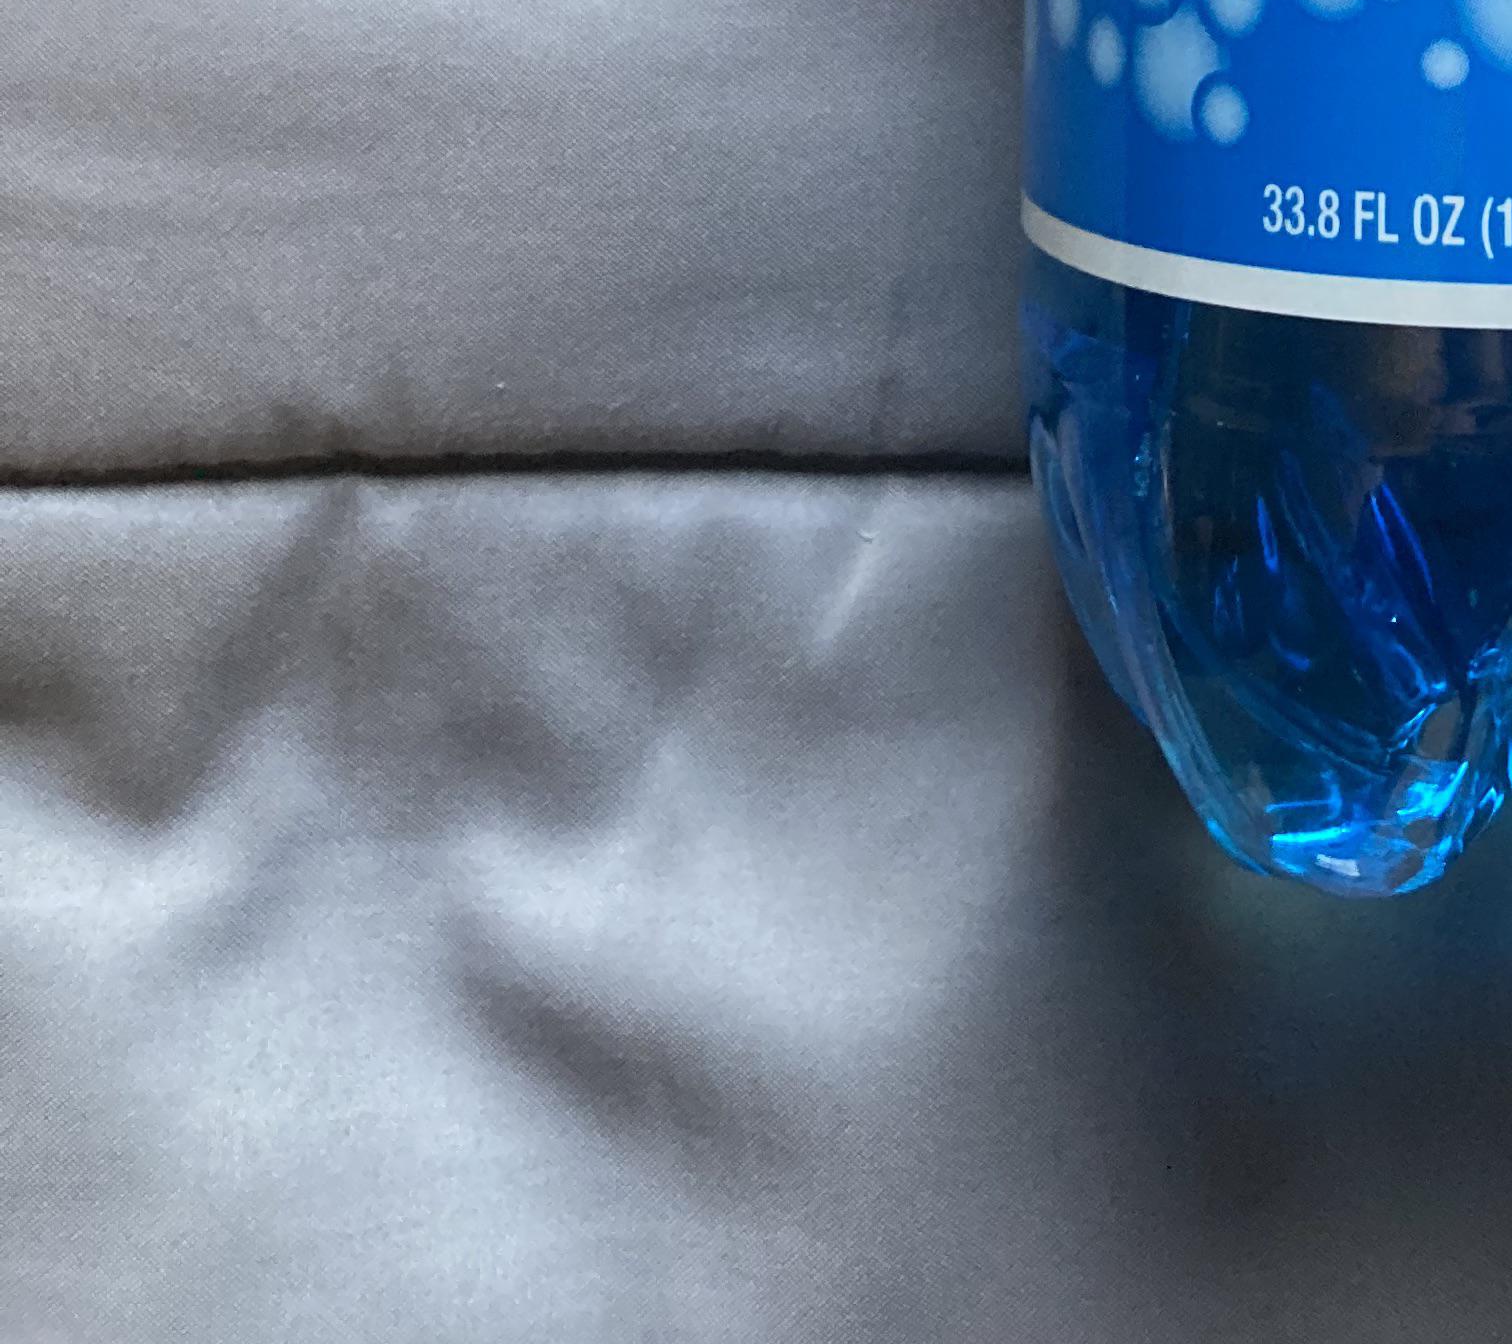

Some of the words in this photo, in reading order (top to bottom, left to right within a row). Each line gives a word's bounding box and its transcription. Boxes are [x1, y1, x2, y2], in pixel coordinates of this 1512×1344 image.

[1262, 183, 1340, 240] 33.8
[1353, 191, 1399, 243] FL
[1413, 193, 1465, 246] OZ
